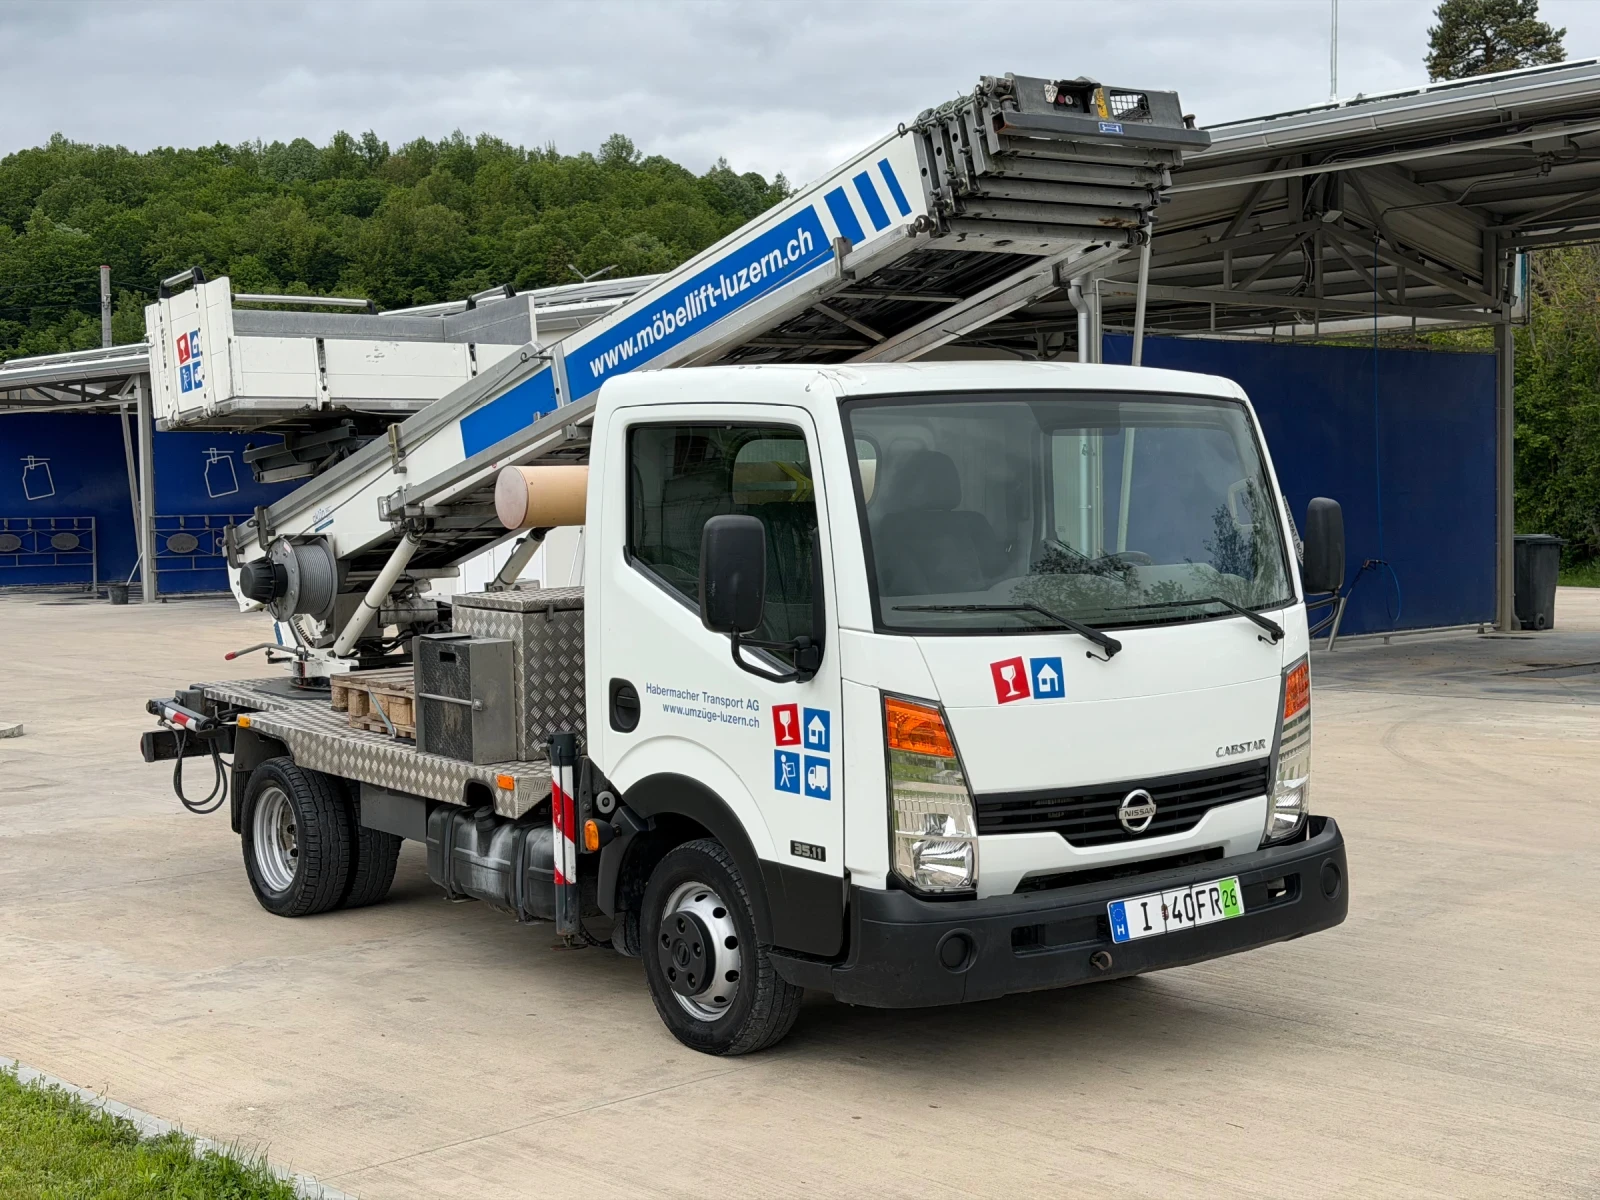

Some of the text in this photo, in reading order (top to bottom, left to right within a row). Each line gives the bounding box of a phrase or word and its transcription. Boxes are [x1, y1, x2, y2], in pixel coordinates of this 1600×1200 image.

[589, 227, 814, 378] www.möbellift-luzern.ch
[646, 682, 760, 712] Habermacher Transport AG
[662, 703, 760, 729] www.umzüge-luzern.ch
[1215, 738, 1266, 758] CABSTAR
[1124, 806, 1155, 818] NISSAN
[794, 842, 822, 860] 35.11
[1222, 887, 1238, 909] 26
[1116, 924, 1126, 936] H
